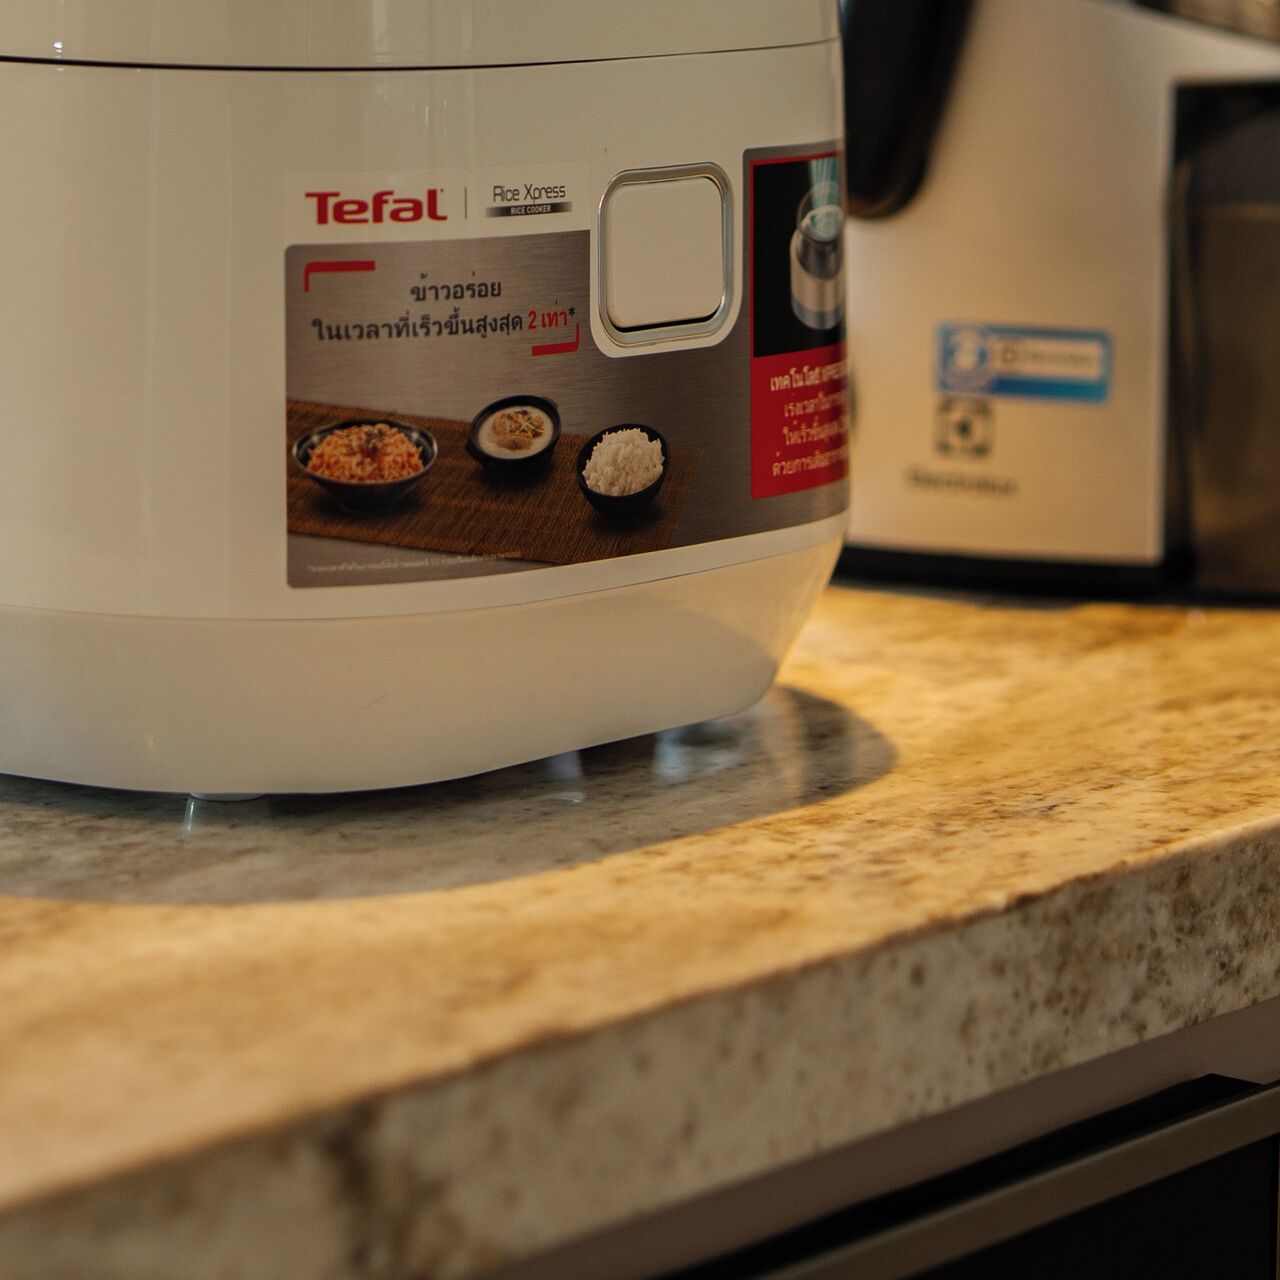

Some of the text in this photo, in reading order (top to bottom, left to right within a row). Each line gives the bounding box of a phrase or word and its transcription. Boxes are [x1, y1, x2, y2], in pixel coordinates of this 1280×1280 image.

[305, 188, 448, 224] Tefal
[493, 183, 566, 204] Rice Xpress
[510, 204, 552, 215] RICE COOKER
[410, 271, 502, 302] ข้าวอร่อย
[311, 307, 523, 341] ในเวลาที่เร็วขึ้นสูงสุด
[527, 310, 537, 330] 2
